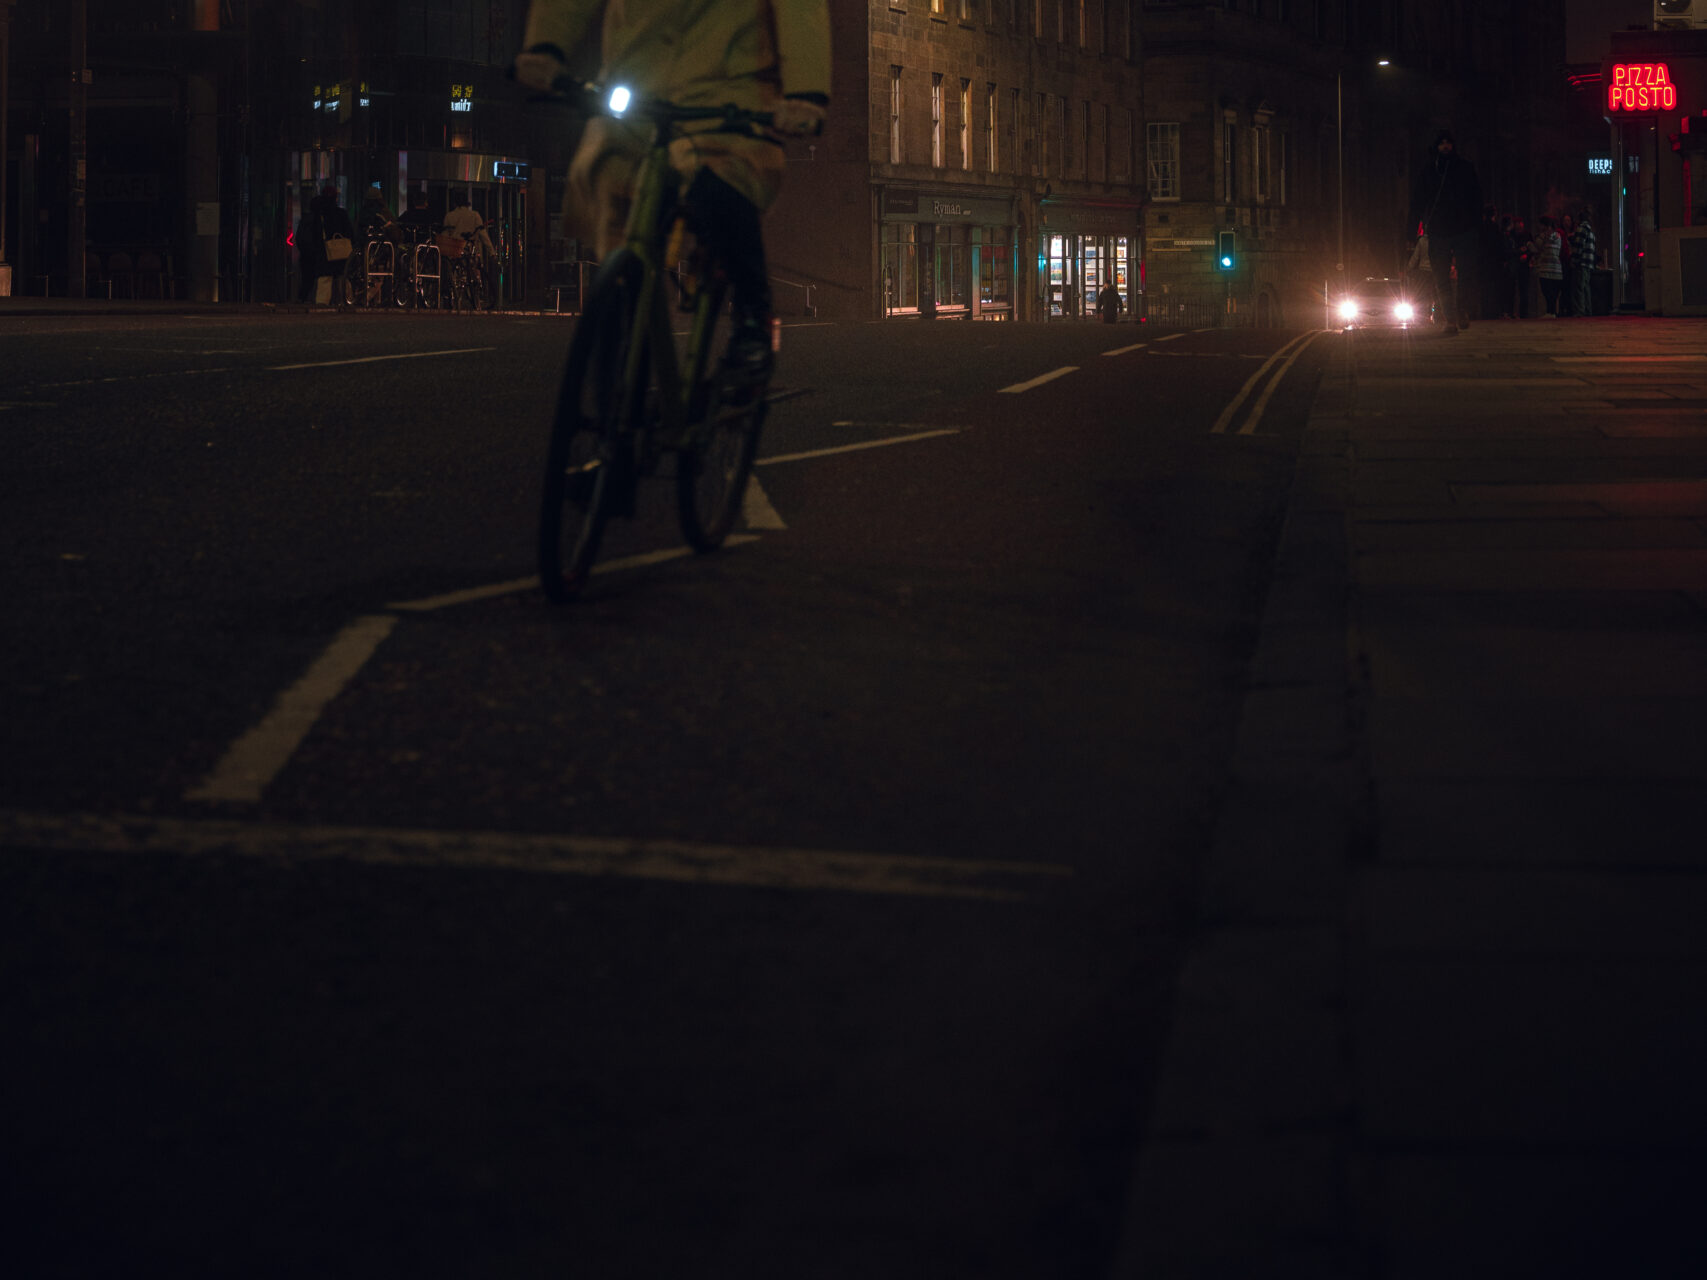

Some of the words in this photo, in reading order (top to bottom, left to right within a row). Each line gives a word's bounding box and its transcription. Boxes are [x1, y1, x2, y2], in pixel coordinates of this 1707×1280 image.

[1615, 66, 1666, 86] PIZZA
[1612, 86, 1673, 108] POSTO
[934, 200, 961, 218] Ryman
